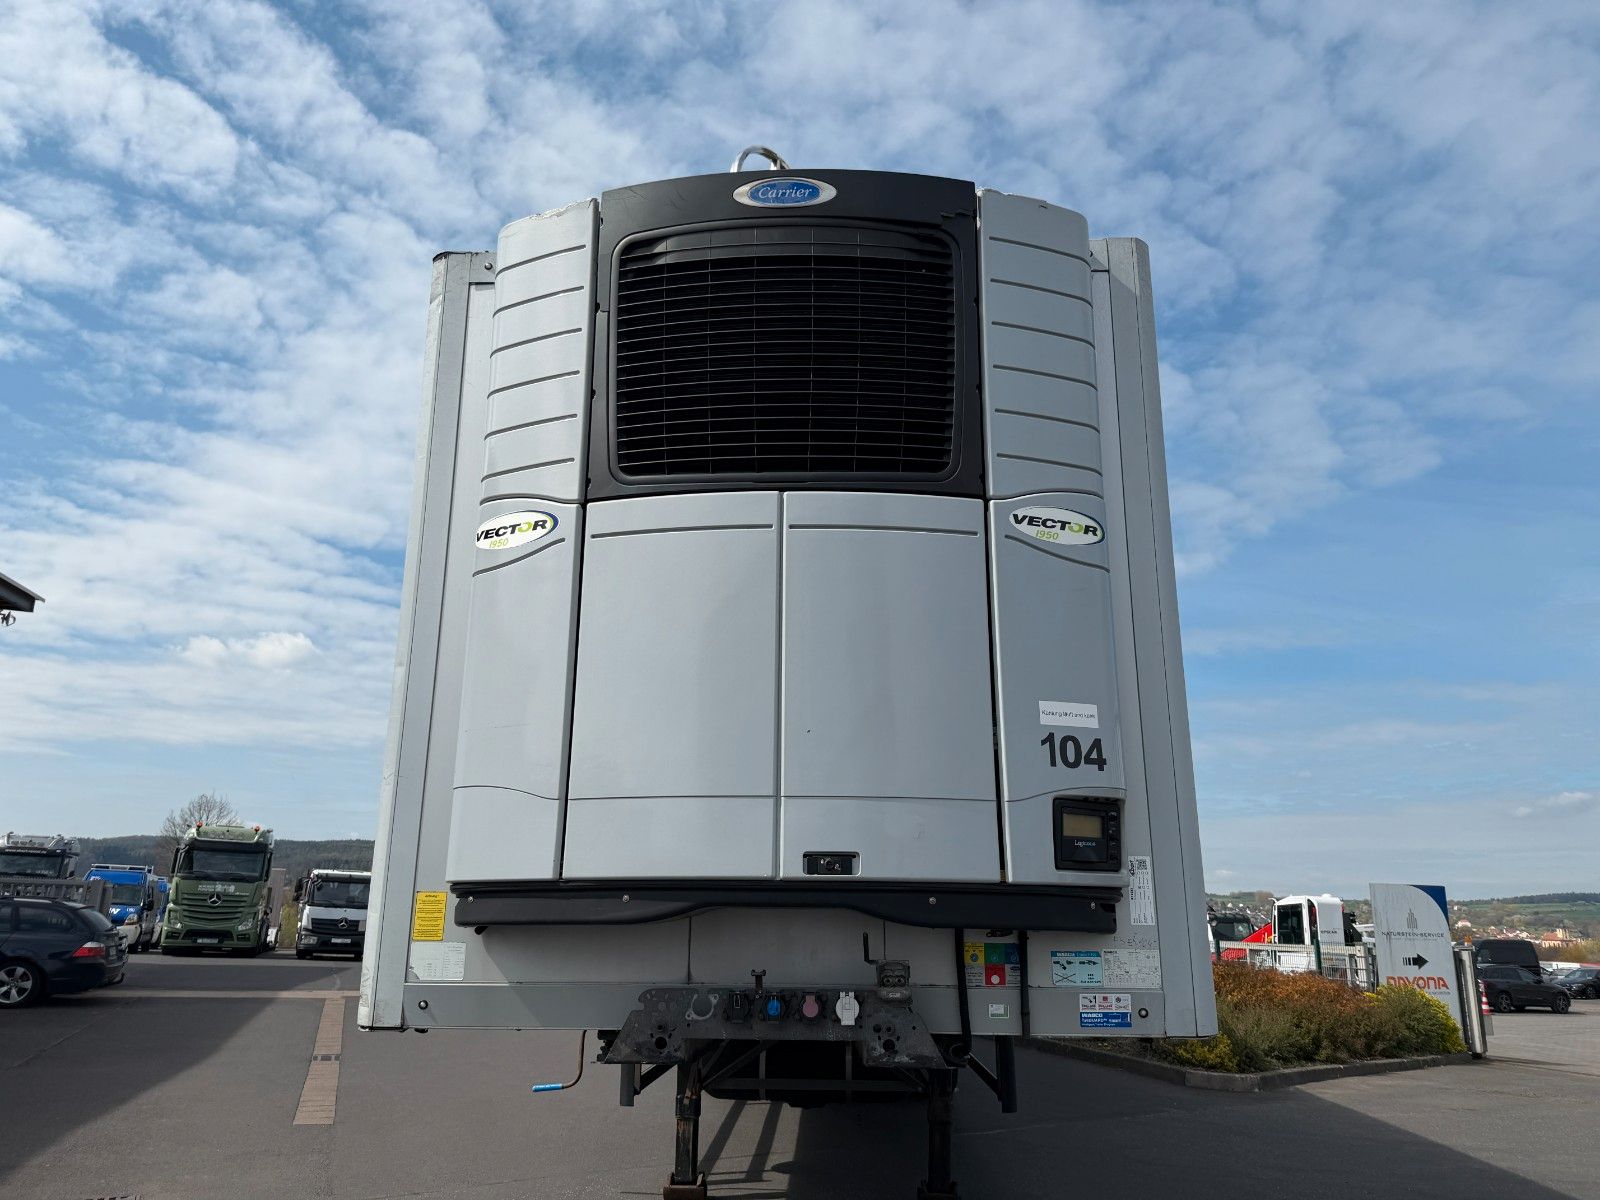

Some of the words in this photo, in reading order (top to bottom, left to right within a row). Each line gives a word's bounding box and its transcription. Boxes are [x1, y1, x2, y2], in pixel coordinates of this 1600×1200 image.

[758, 186, 813, 199] Carrier
[476, 519, 548, 542] VECTOR
[1012, 513, 1098, 537] VECTOR
[489, 538, 509, 548] 1950
[1035, 529, 1059, 540] 1950
[1040, 731, 1107, 772] 104
